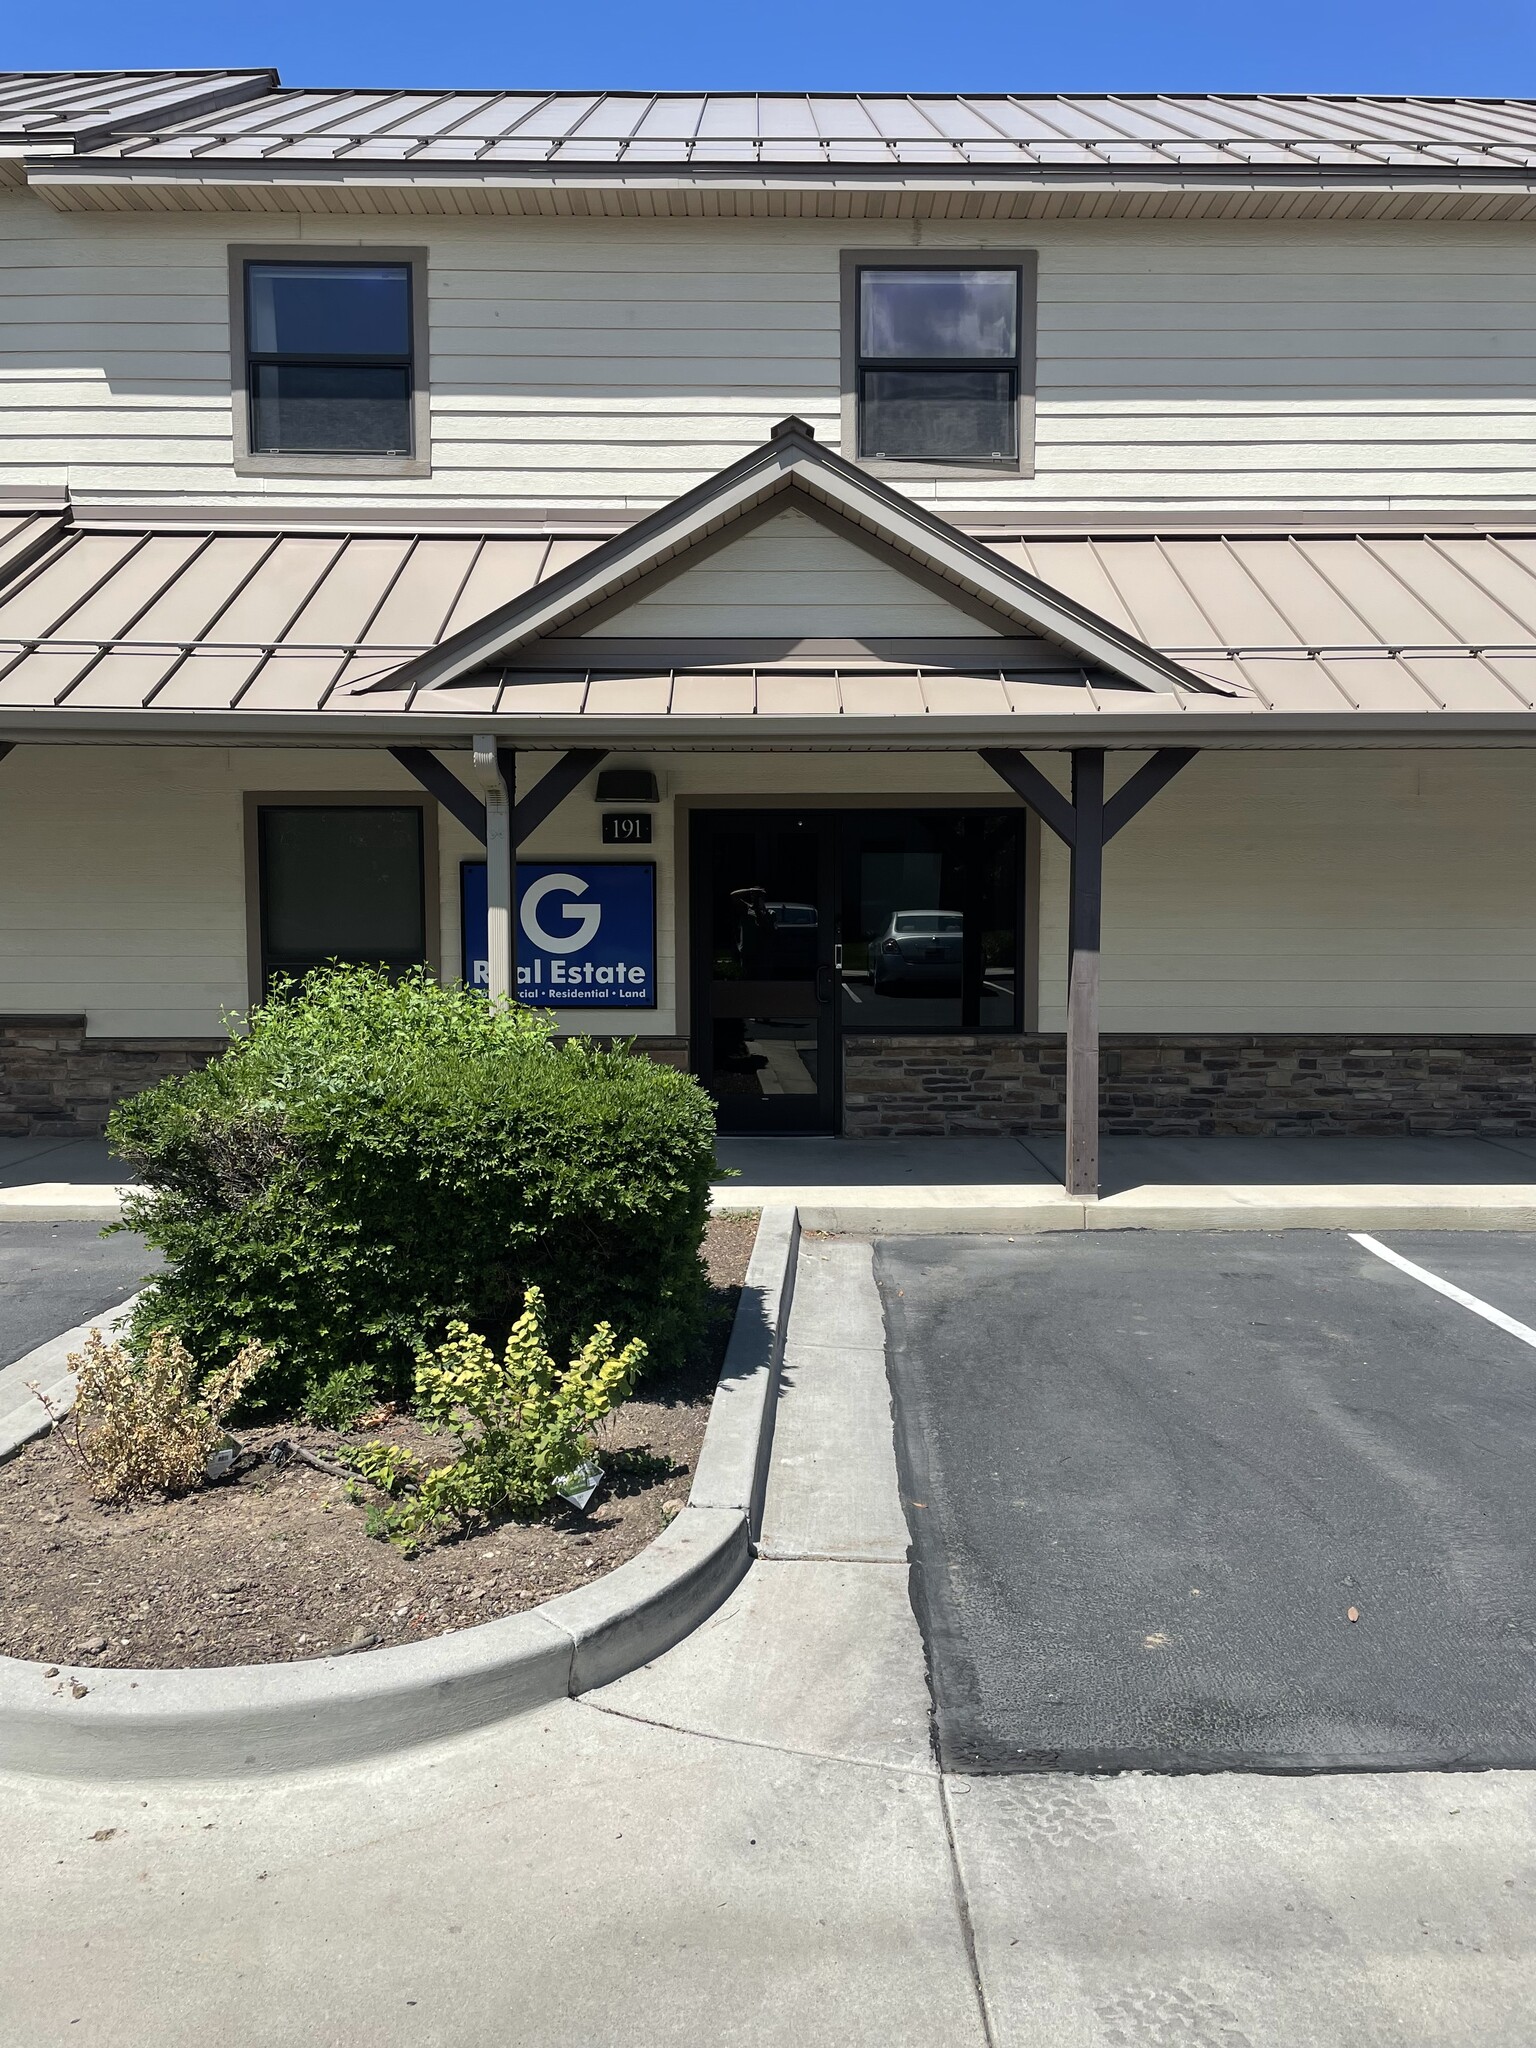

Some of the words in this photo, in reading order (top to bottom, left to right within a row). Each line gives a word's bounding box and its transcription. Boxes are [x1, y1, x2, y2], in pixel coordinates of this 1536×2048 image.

[613, 819, 641, 838] 191
[519, 872, 601, 954] G
[473, 958, 542, 984] Ral
[550, 959, 646, 984] Estate
[549, 988, 609, 998] Residential
[619, 988, 646, 998] Land
